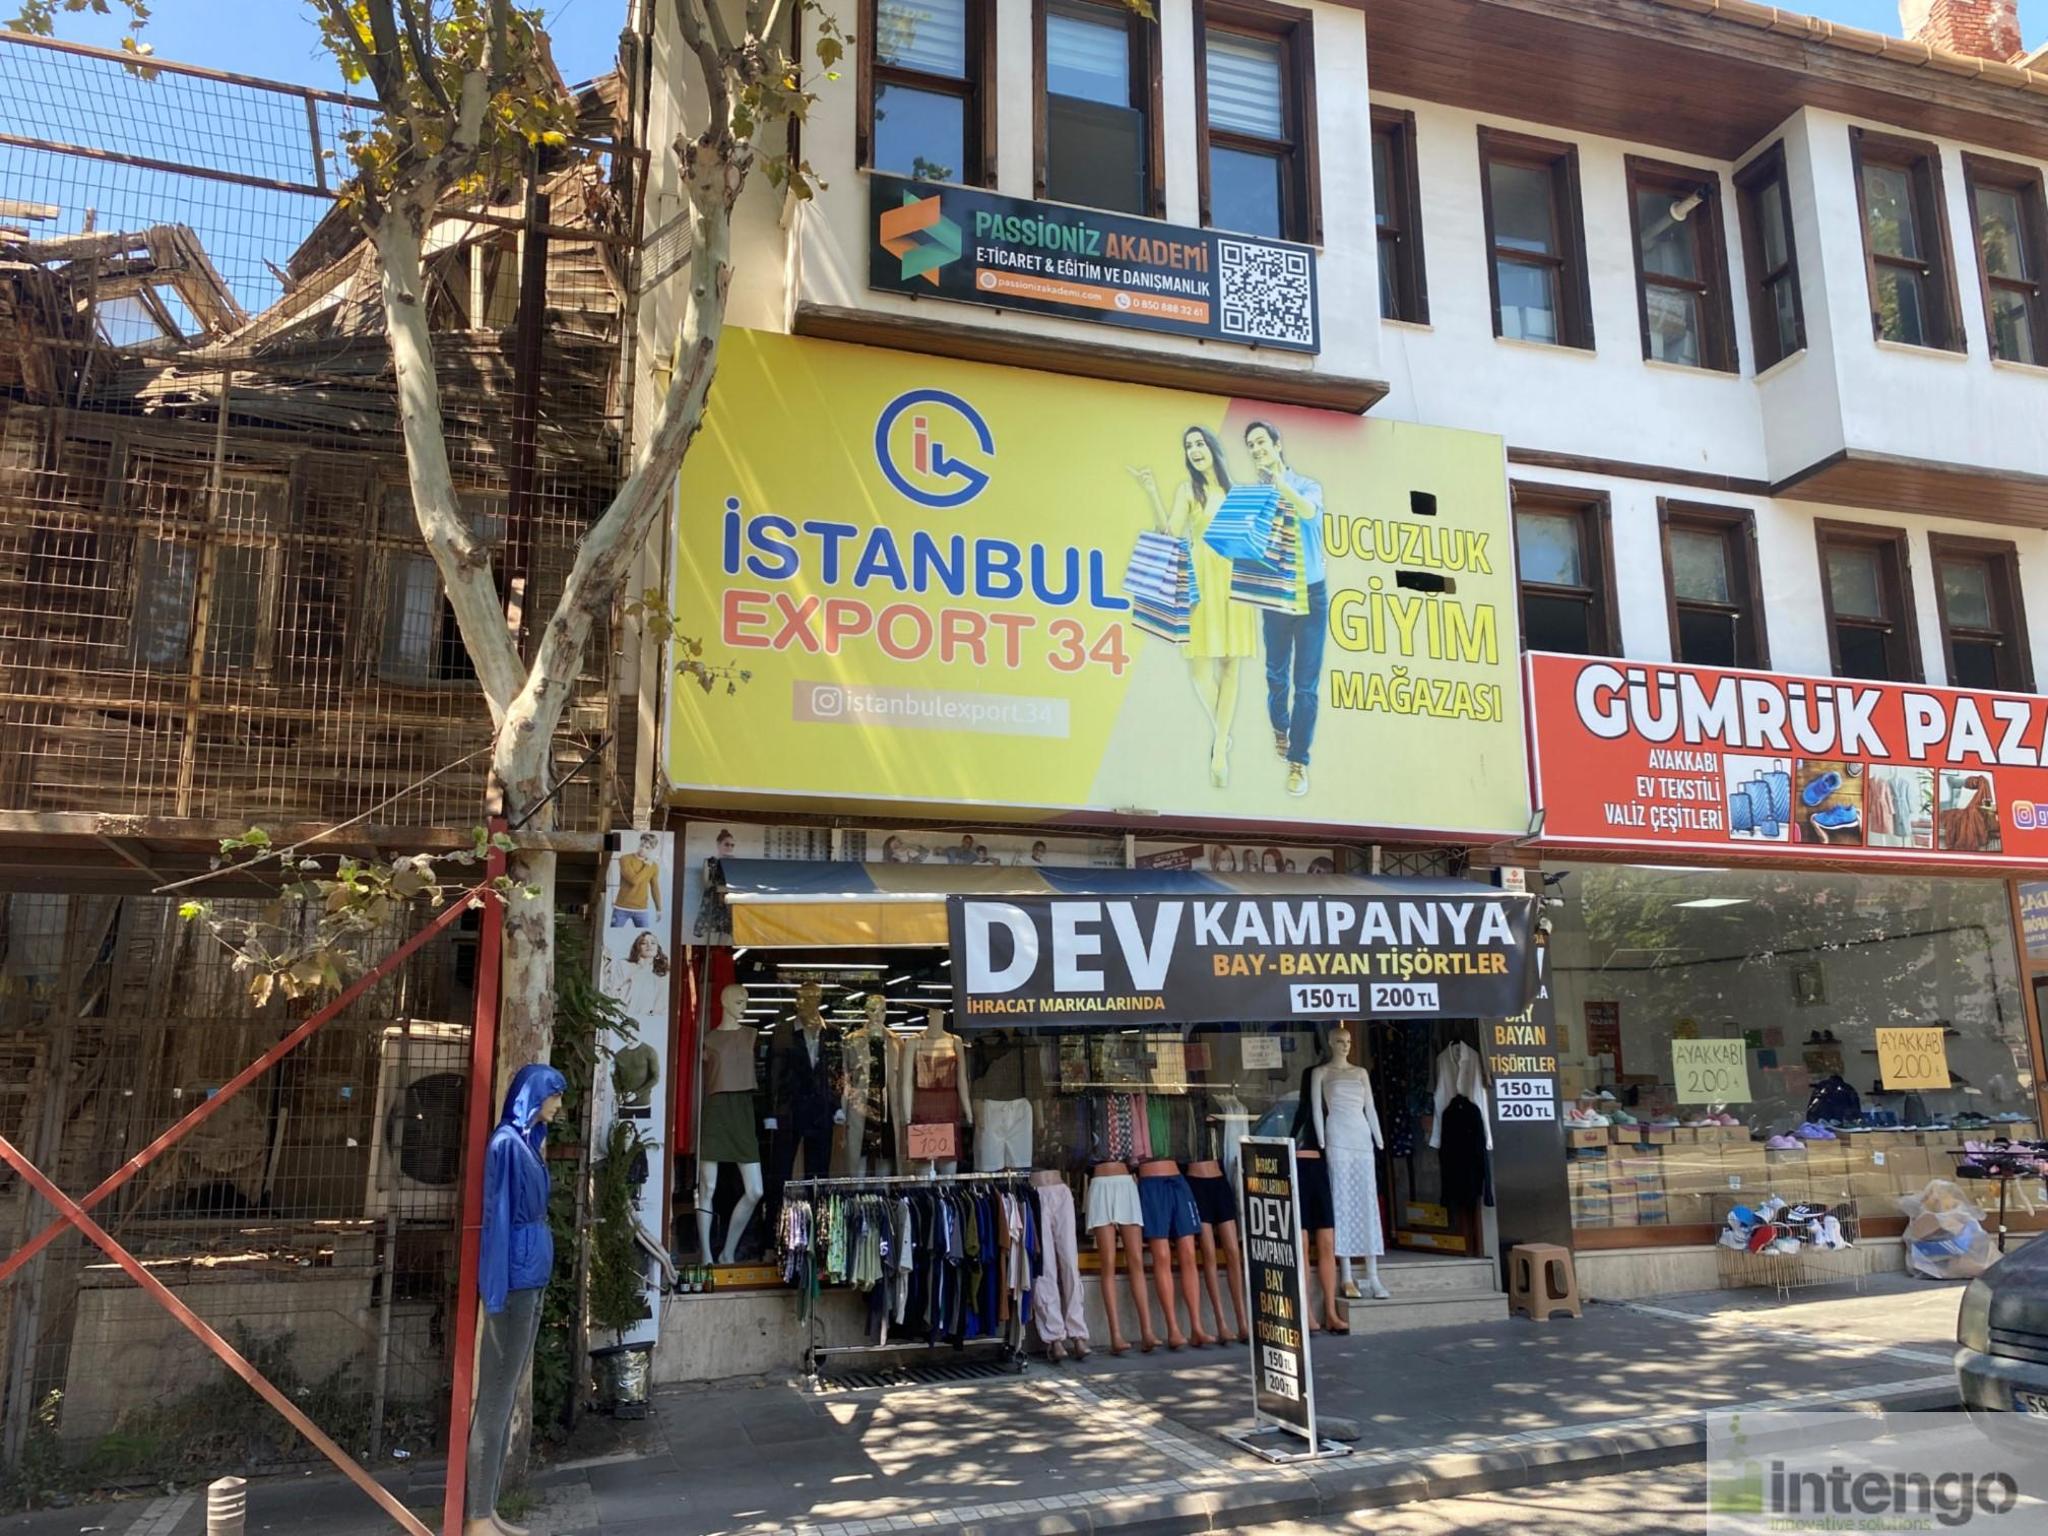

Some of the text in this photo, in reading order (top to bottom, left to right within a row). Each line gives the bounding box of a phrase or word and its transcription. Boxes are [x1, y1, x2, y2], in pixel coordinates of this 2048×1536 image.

[975, 211, 1209, 273] PASSİONİZ AKADEMİ
[976, 246, 1210, 297] E-TİCARET & EĞİTİM VE DANIŞMANLIK
[721, 496, 1131, 611] İSTANBUL
[1322, 512, 1493, 575] UCUZLUK
[721, 589, 1130, 675] EXPORT 34
[1329, 576, 1499, 665] GİYİM
[1330, 665, 1503, 722] MAĞAZASI
[1574, 662, 2048, 769] GÜMRÜK PAZ
[1649, 748, 1718, 773] AYAKKABI
[1636, 775, 1721, 802] EV TEKSTİLİ
[1604, 800, 1723, 833] VALİZ ÇEŞİTLERİ
[963, 900, 1516, 996] DEV KAMPANYA
[1376, 946, 1508, 981] TİŞÖRTLER
[966, 994, 1165, 1015] İHRACAT MARKALARINDA
[1296, 986, 1437, 1010] 150 TL 200 TL
[1495, 1025, 1547, 1046] BAYAN
[1880, 1031, 1942, 1055] AYAKKABI
[1489, 1054, 1556, 1075] TİŞÖRTLER
[1676, 1044, 1743, 1067] AYAKKABI
[1500, 1082, 1550, 1096] 150 TL
[1502, 1104, 1551, 1118] 200 TL
[1248, 1196, 1291, 1240] DEV
[1250, 1238, 1295, 1268] KAMPANYA
[1264, 1268, 1284, 1292] BAY
[1260, 1291, 1293, 1320] BAYAN
[1257, 1319, 1301, 1348] TİŞÖRTLER
[1268, 1350, 1292, 1371] 150 TL
[1269, 1374, 1294, 1396] 200 TL
